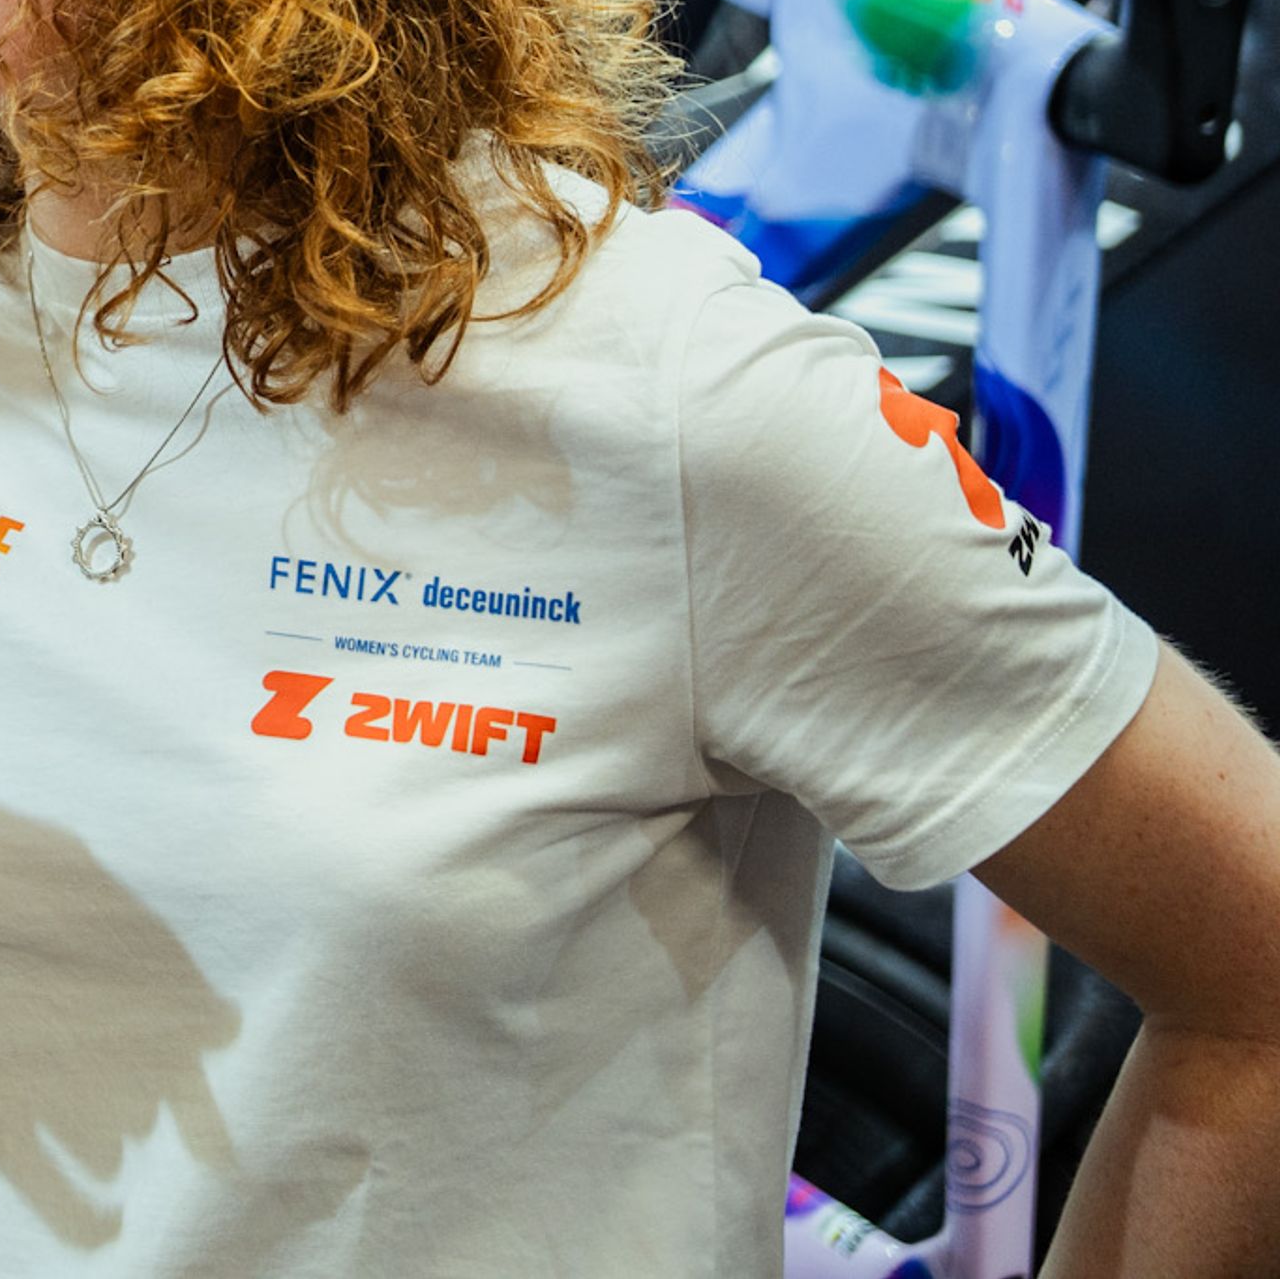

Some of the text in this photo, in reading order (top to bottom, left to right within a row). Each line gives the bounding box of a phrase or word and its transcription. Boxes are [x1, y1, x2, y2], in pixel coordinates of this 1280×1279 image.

[269, 556, 581, 624] FENIX deceuninck
[334, 635, 502, 668] WOMEN'S CYCLING TEAM
[344, 692, 558, 764] ZWIFT
